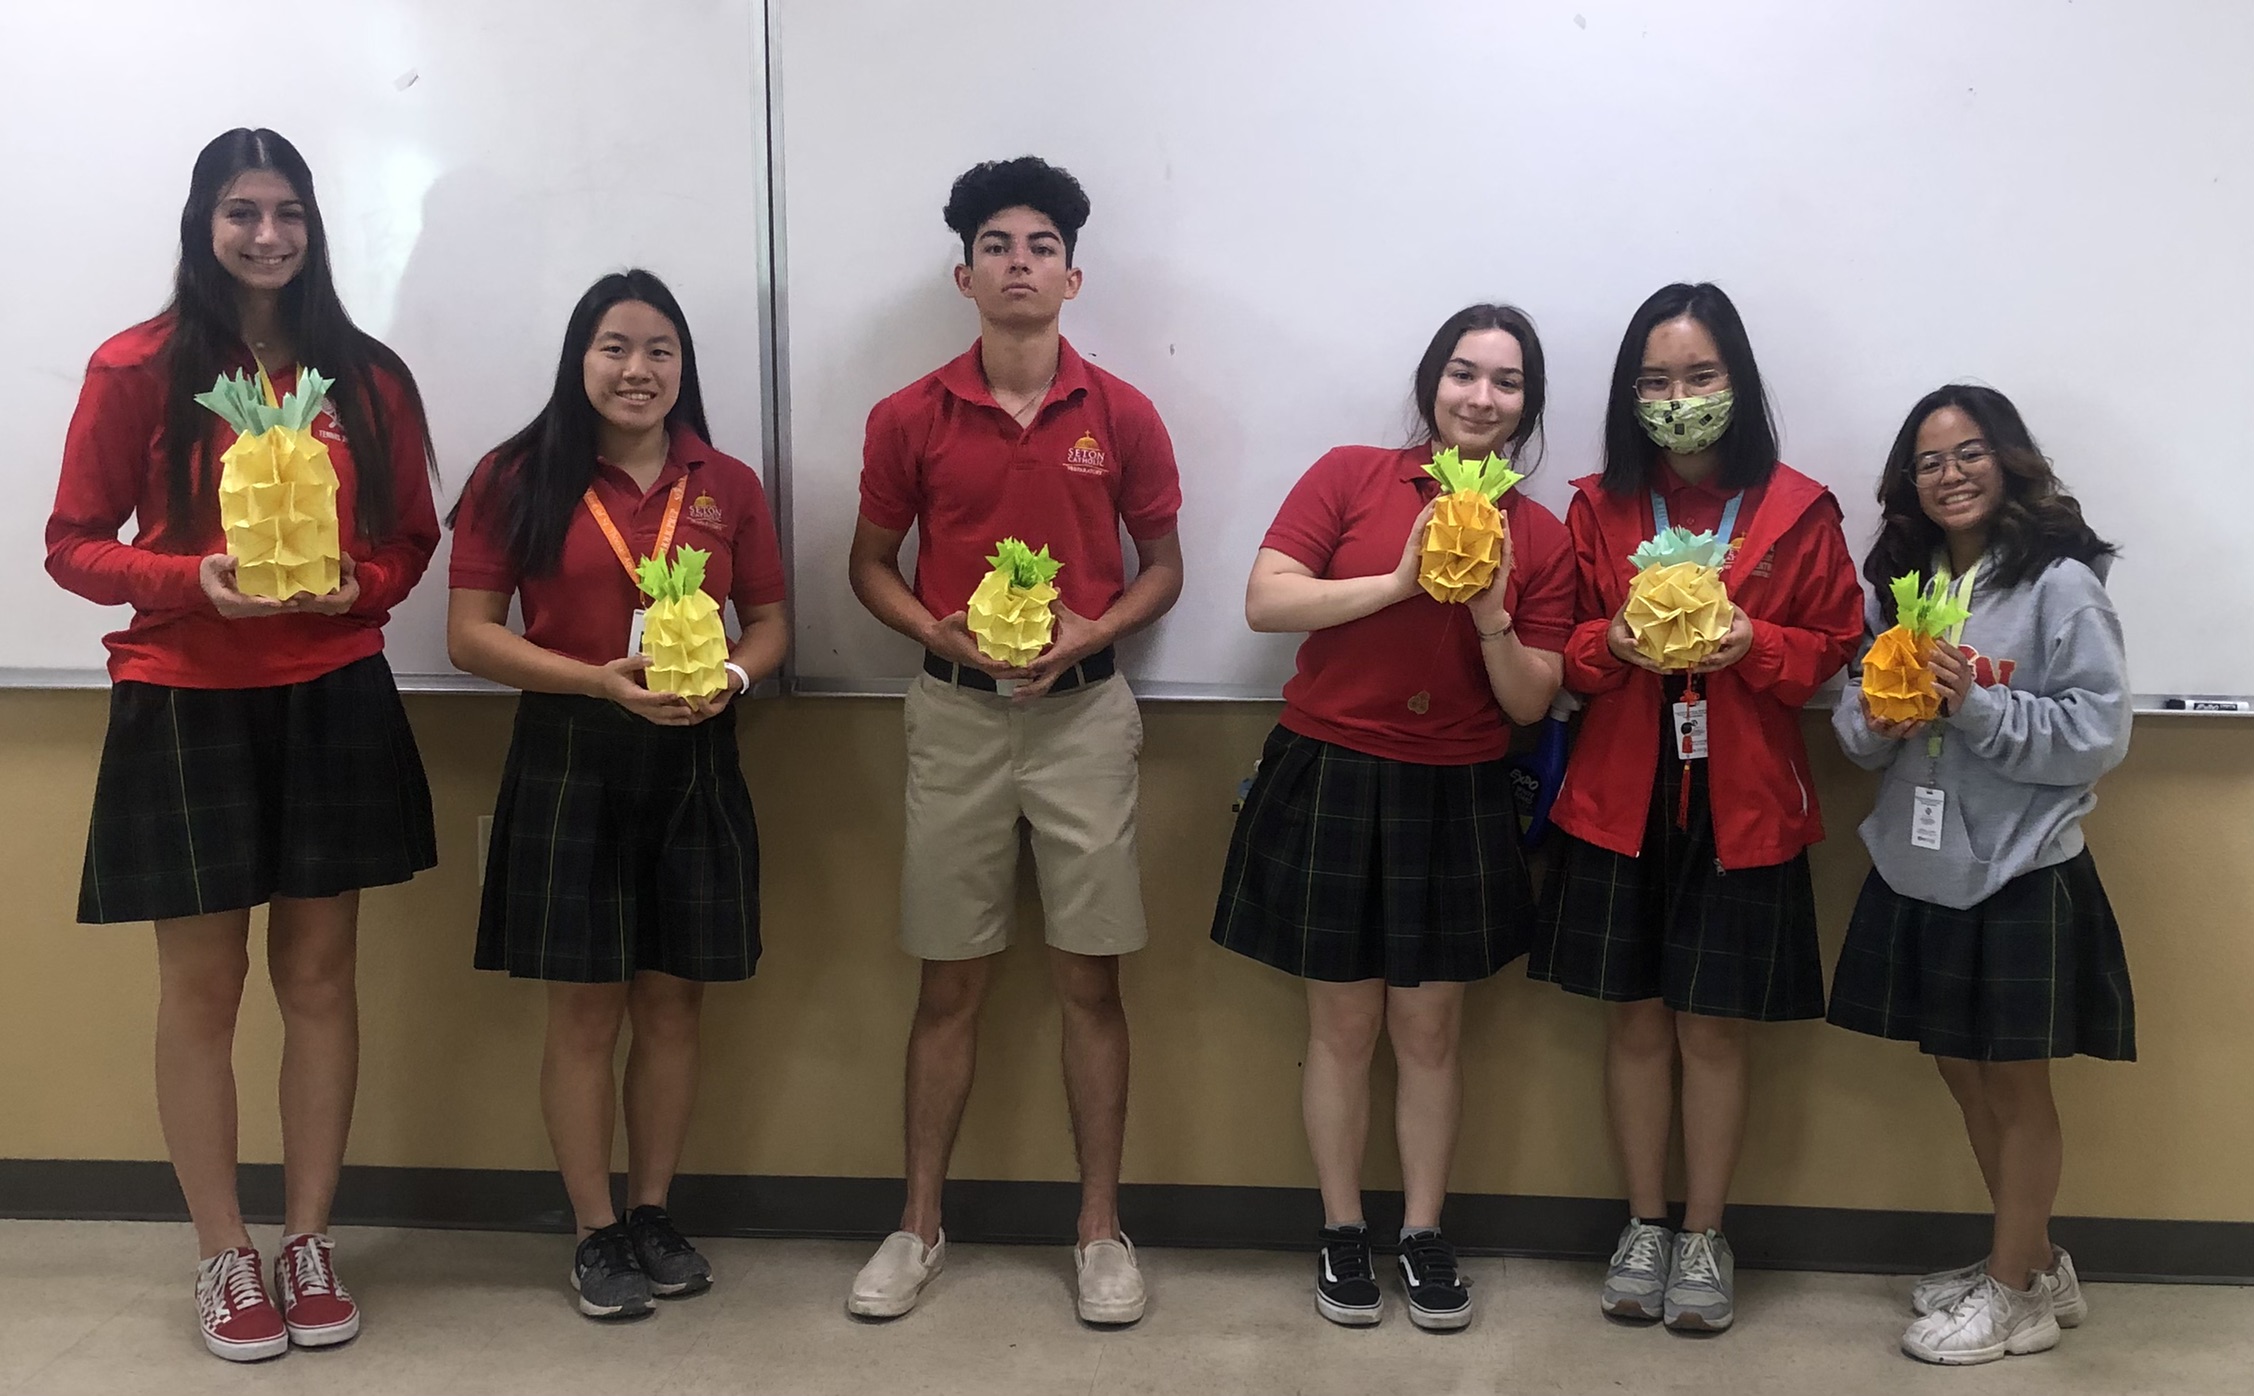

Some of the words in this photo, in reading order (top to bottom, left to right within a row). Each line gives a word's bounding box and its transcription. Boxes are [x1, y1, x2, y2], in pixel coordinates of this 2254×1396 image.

[1068, 448, 1105, 460] SETON
[1067, 455, 1104, 467] CATHOLIC
[689, 505, 722, 517] SETON
[1509, 768, 1539, 790] EXPO
